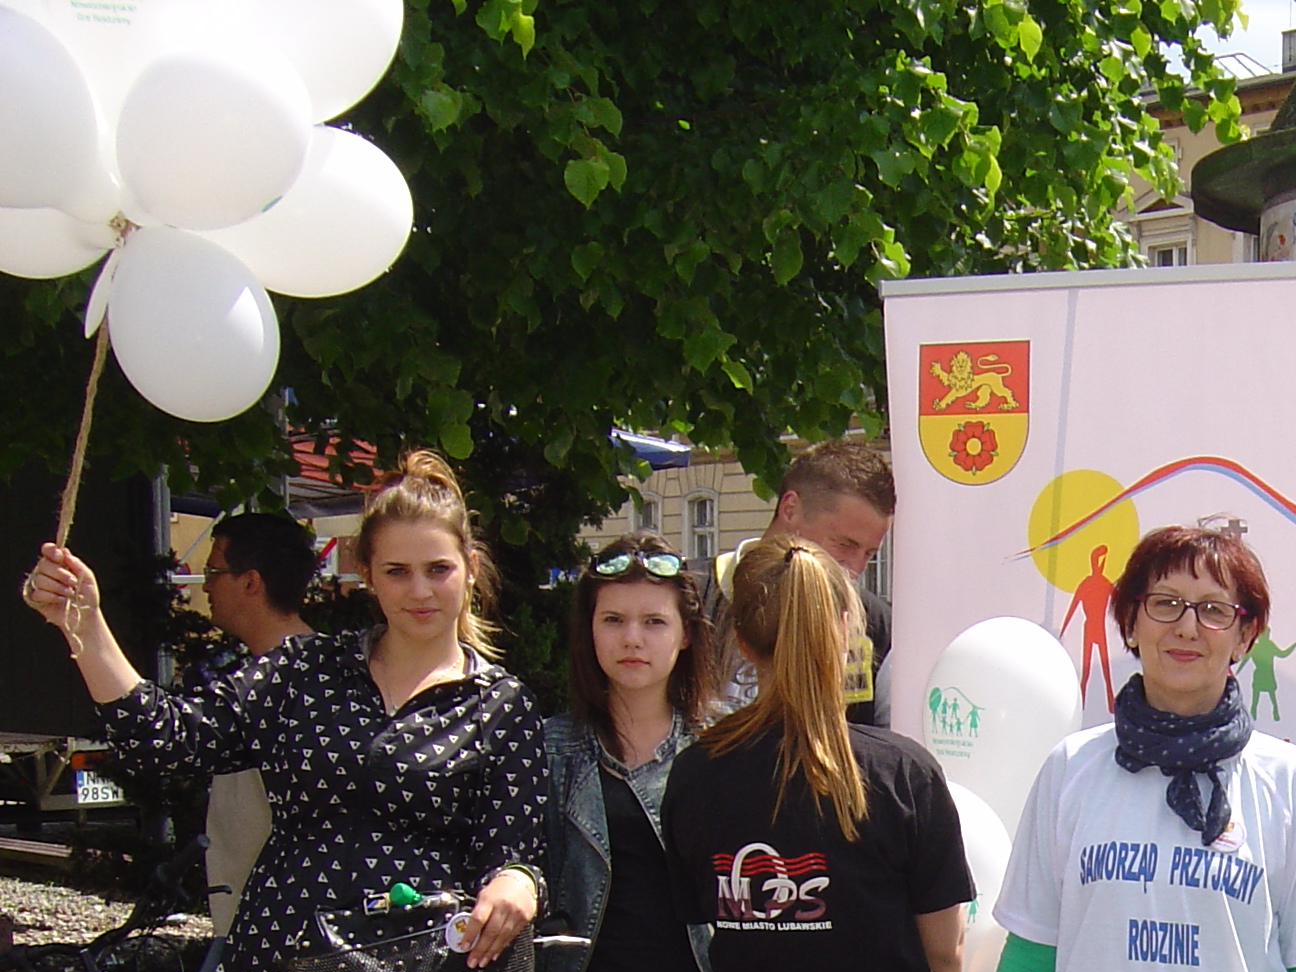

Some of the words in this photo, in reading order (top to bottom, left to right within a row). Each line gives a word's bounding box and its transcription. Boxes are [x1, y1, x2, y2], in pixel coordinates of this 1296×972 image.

[1079, 840, 1159, 895] SAMORZĄD
[1169, 846, 1264, 905] PRZYJAZNY
[742, 921, 776, 931] MIASTO
[778, 920, 833, 931] LUBAWSKIE
[1128, 918, 1200, 967] RODZINIE
